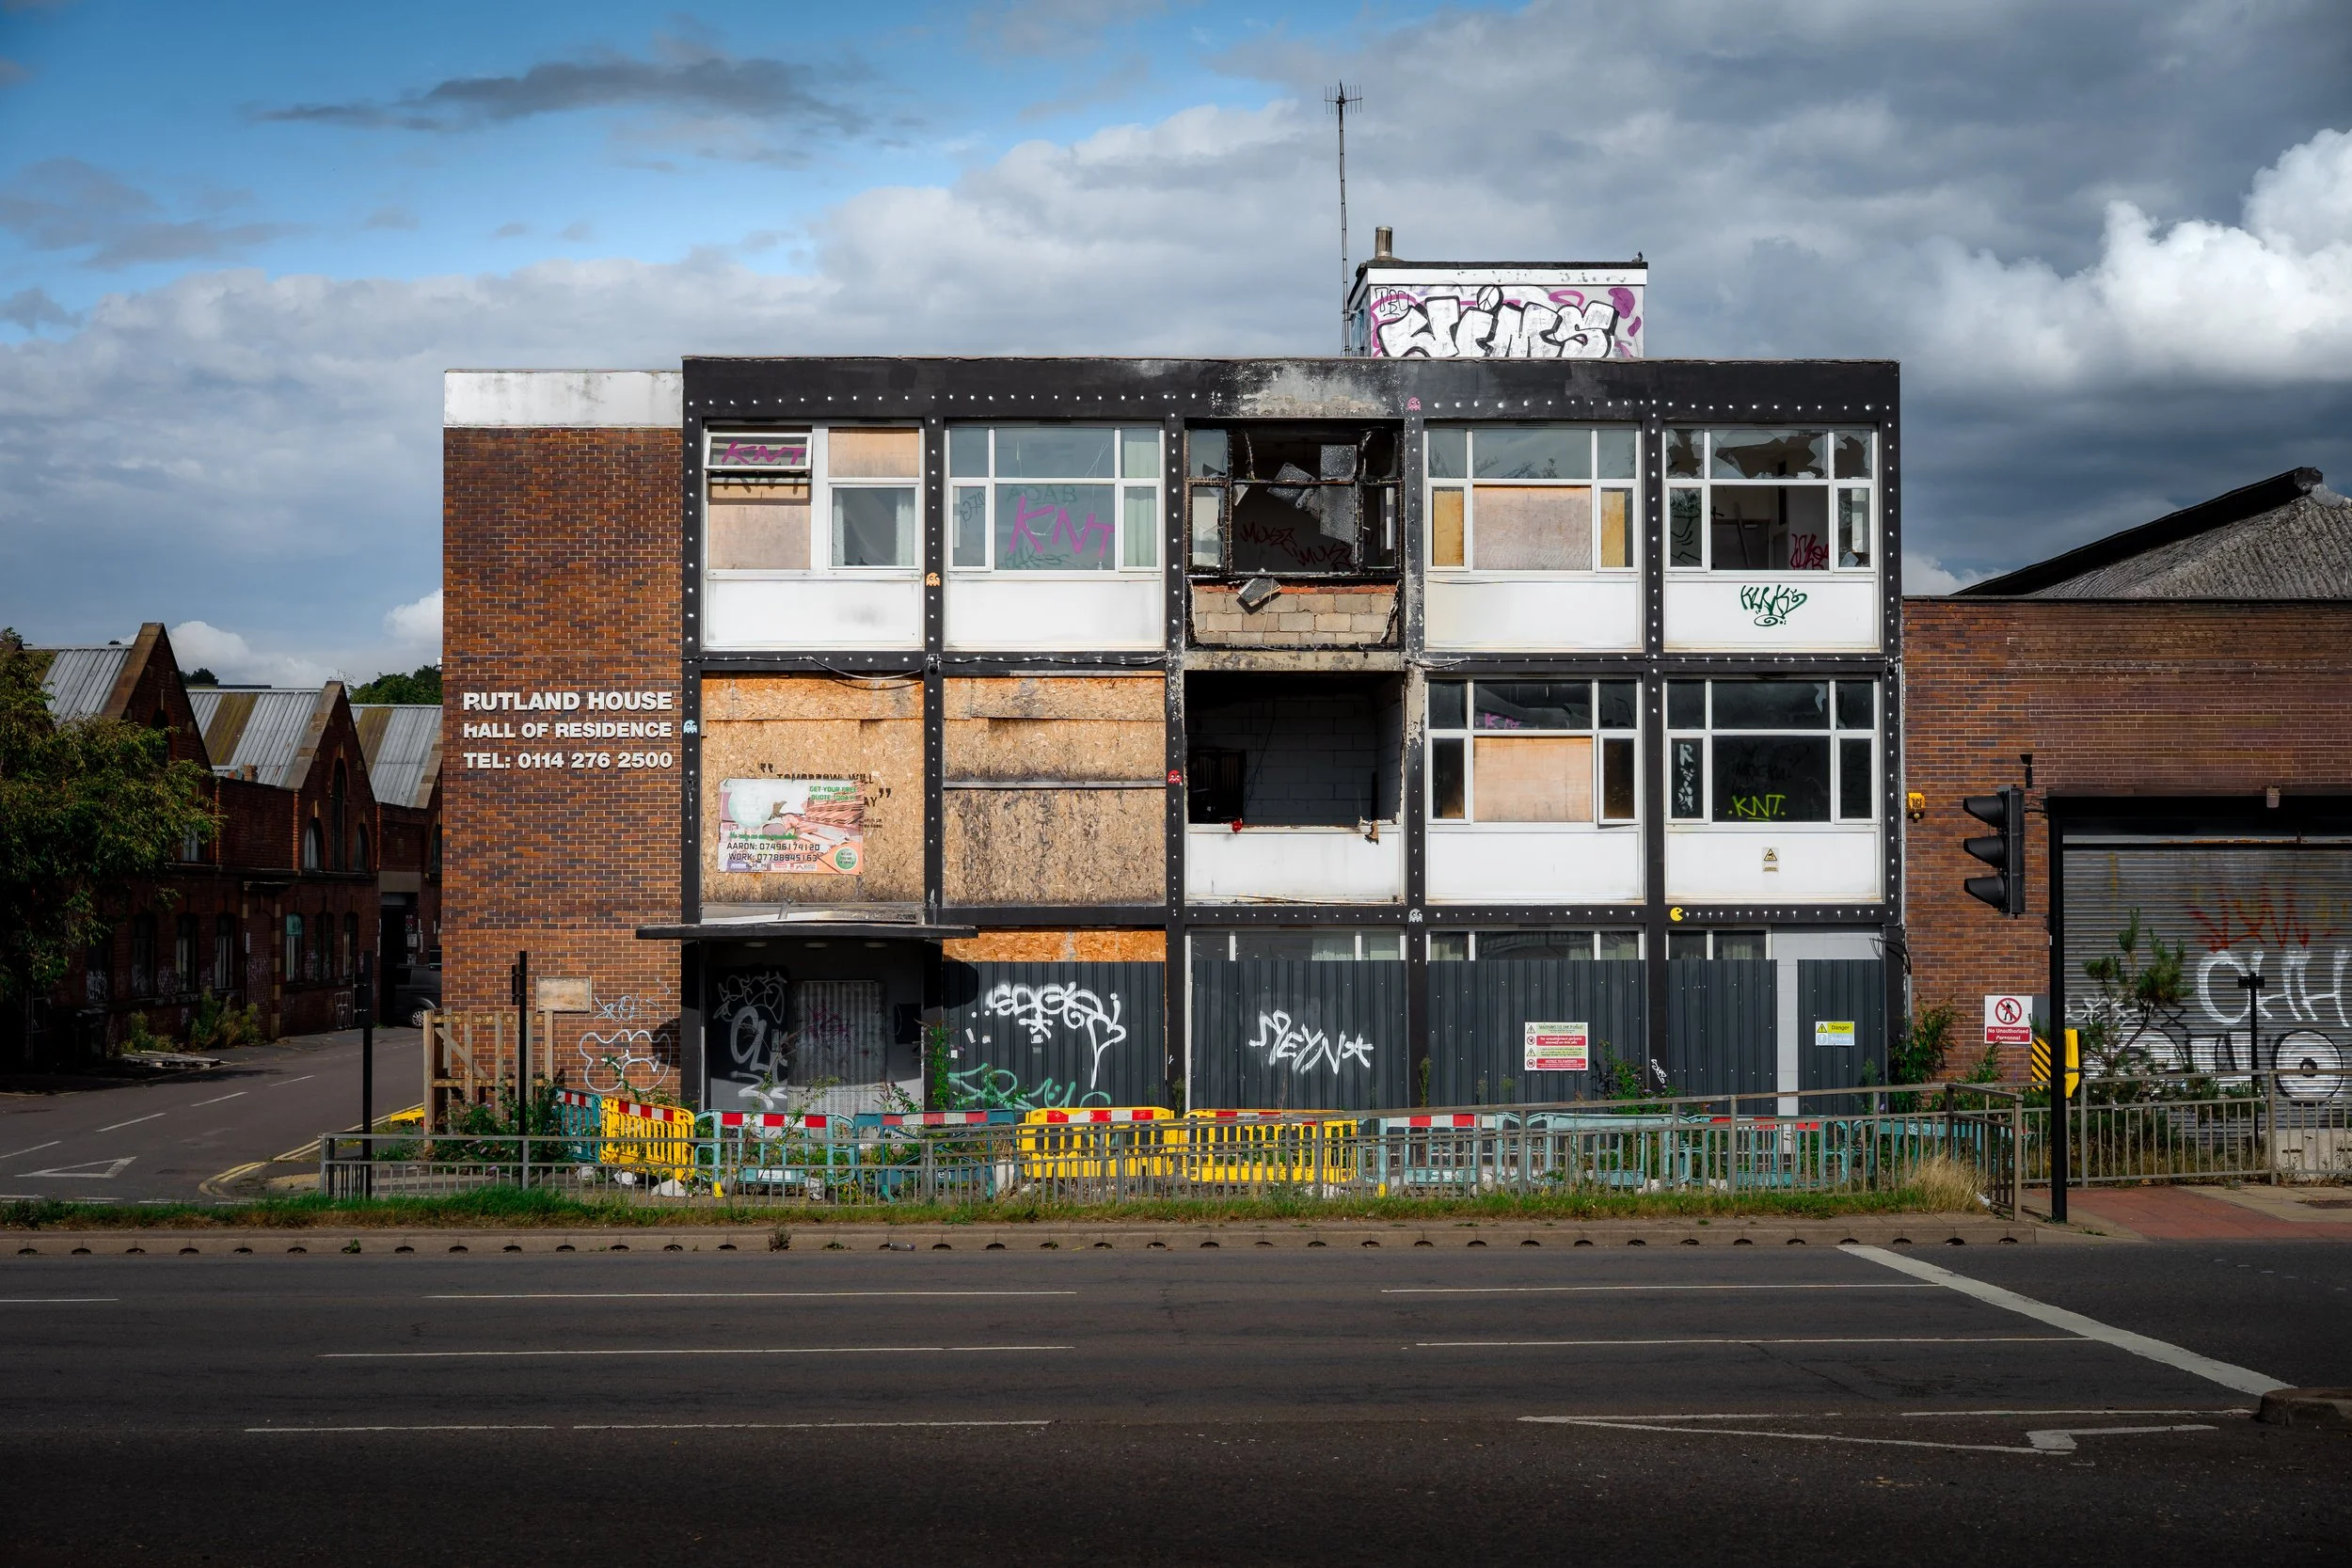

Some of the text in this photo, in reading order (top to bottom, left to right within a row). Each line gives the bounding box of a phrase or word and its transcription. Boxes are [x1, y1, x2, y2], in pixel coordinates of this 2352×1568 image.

[1009, 495, 1116, 557] KNT
[463, 692, 673, 711] RUTLAND HOUSE
[463, 722, 673, 738] HALL OF RESIDENCE
[463, 752, 673, 768] TEL: 0114 276 2500
[726, 842, 820, 851] AARON: 07496174120
[728, 852, 755, 861] WORK:
